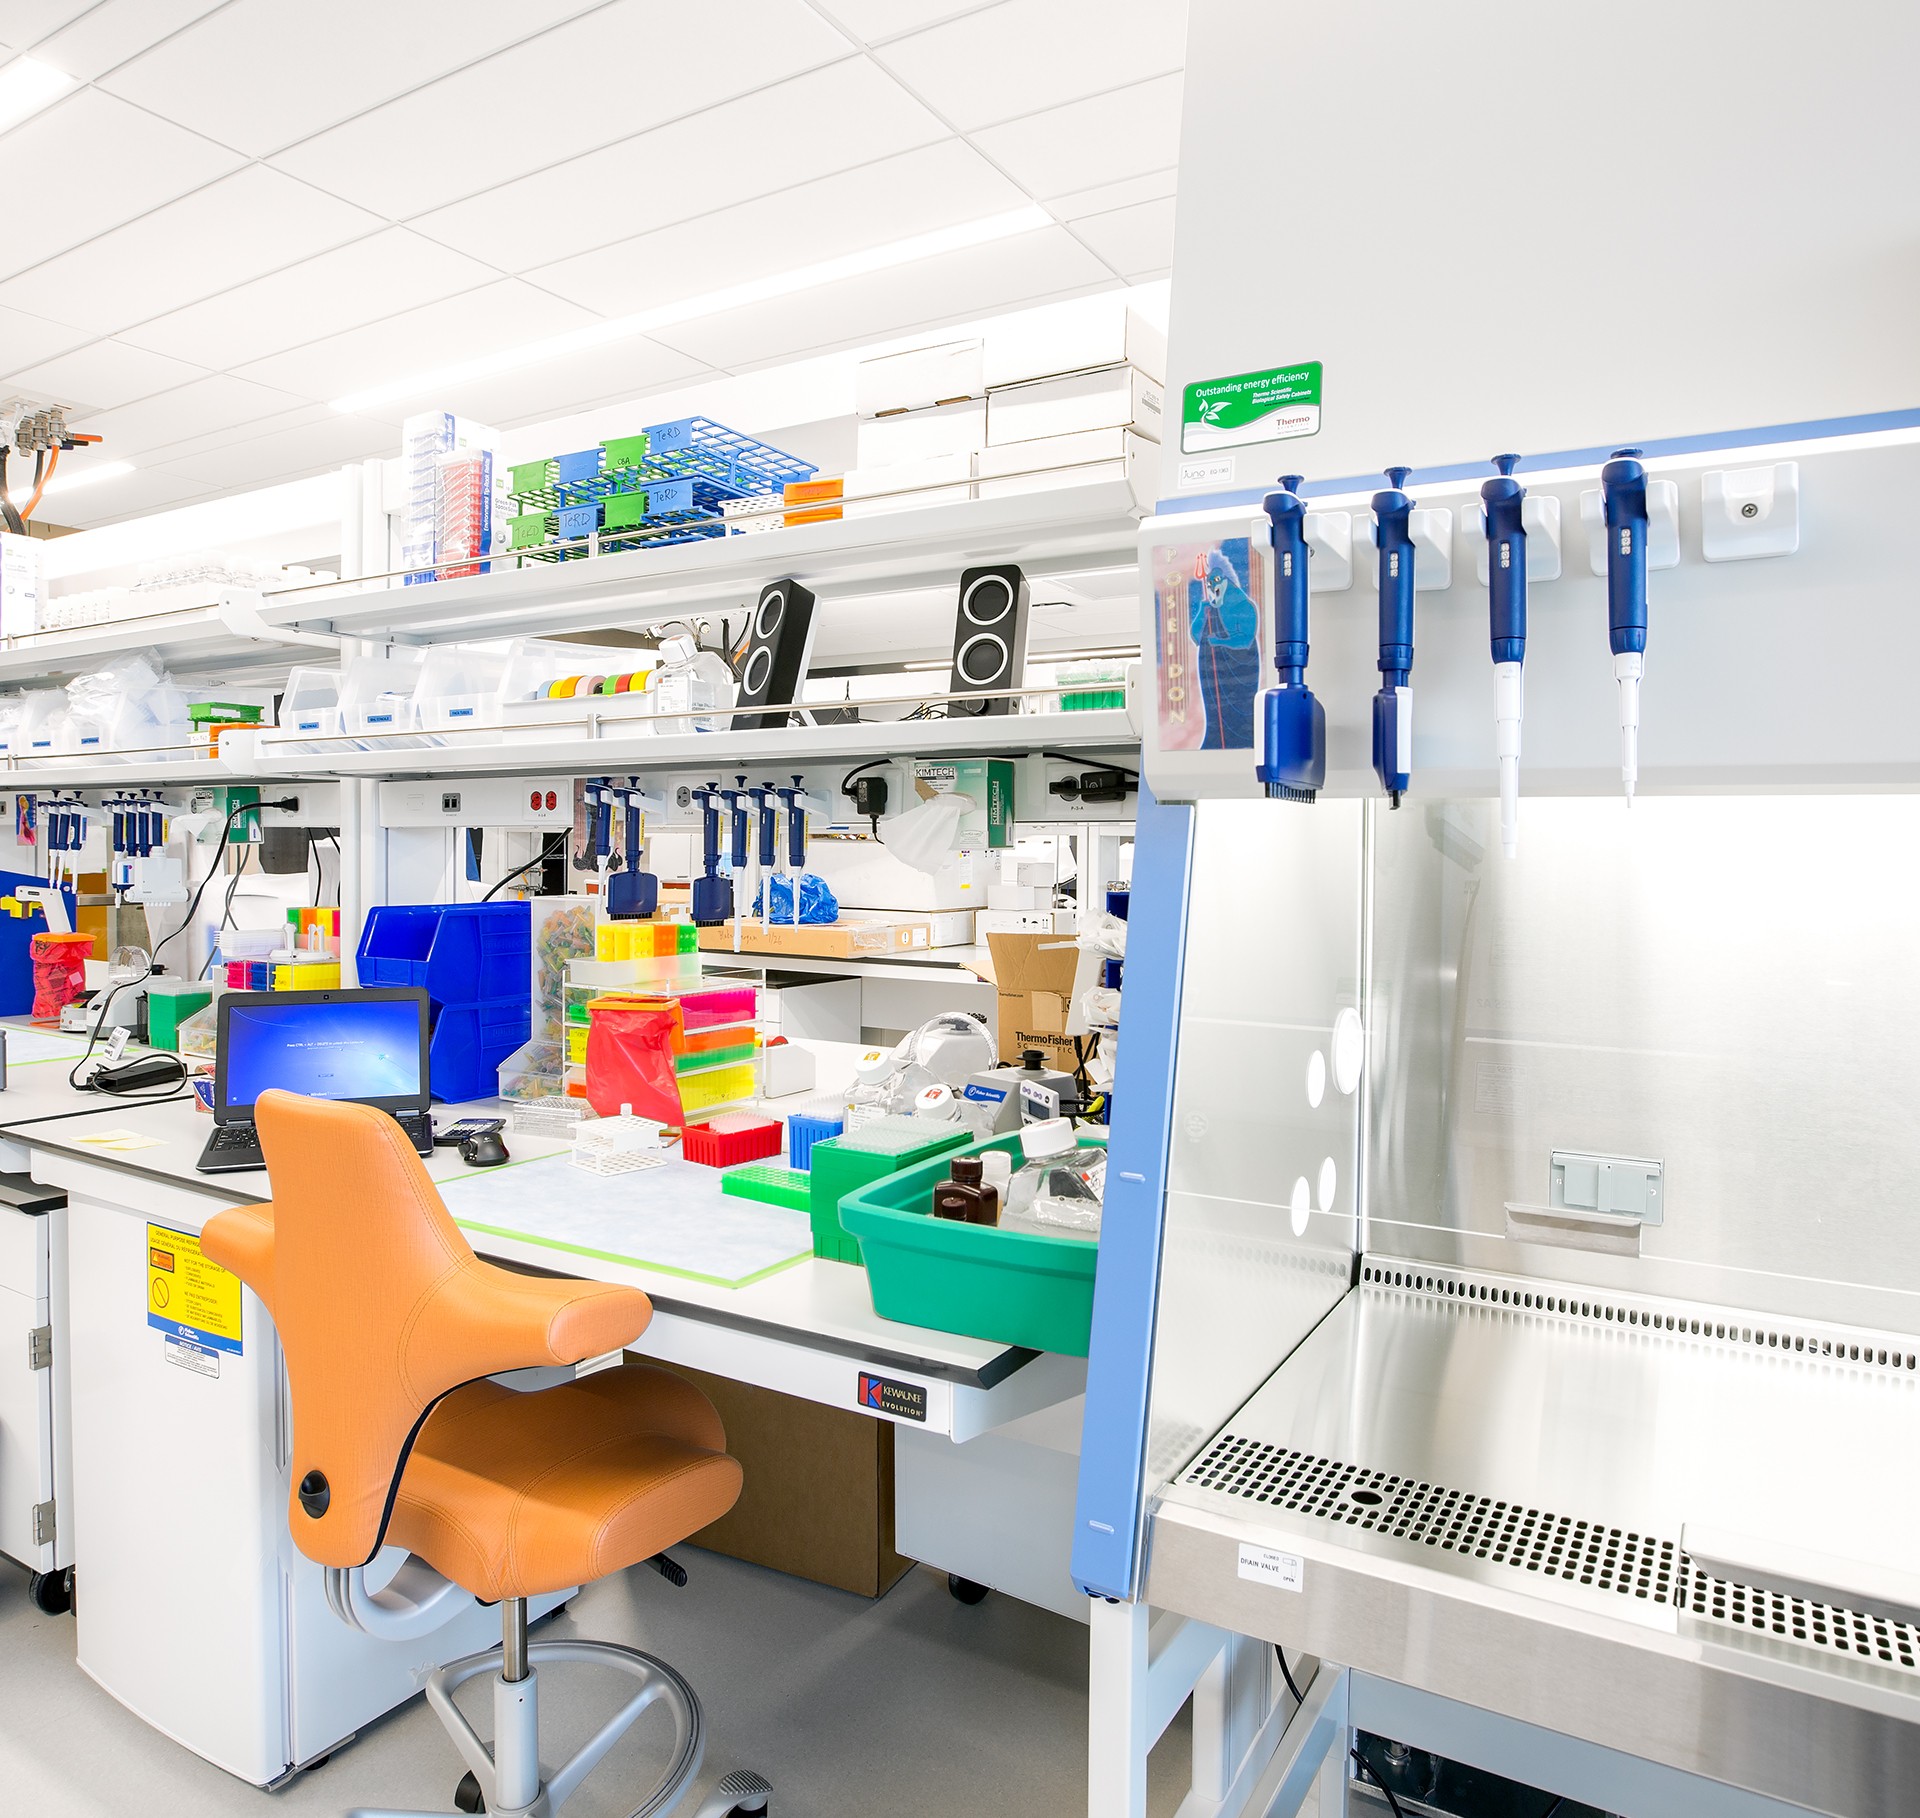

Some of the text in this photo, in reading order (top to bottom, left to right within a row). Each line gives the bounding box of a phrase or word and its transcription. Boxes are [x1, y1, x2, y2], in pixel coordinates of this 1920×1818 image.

[1195, 371, 1310, 398] Outstanding energy efficiency
[1251, 389, 1312, 405] Biological Safety Cabinets
[1252, 386, 1293, 399] Thermo Scientific
[1276, 415, 1311, 427] Thermo
[1166, 548, 1186, 724] POSEIDON
[915, 767, 956, 776] KIMTECH
[1015, 1031, 1074, 1046] ThermoFisher
[986, 1091, 1001, 1099] Scientific
[883, 1386, 922, 1404] KEWAUNEE
[1240, 1558, 1279, 1572] DRAIN VALVE
